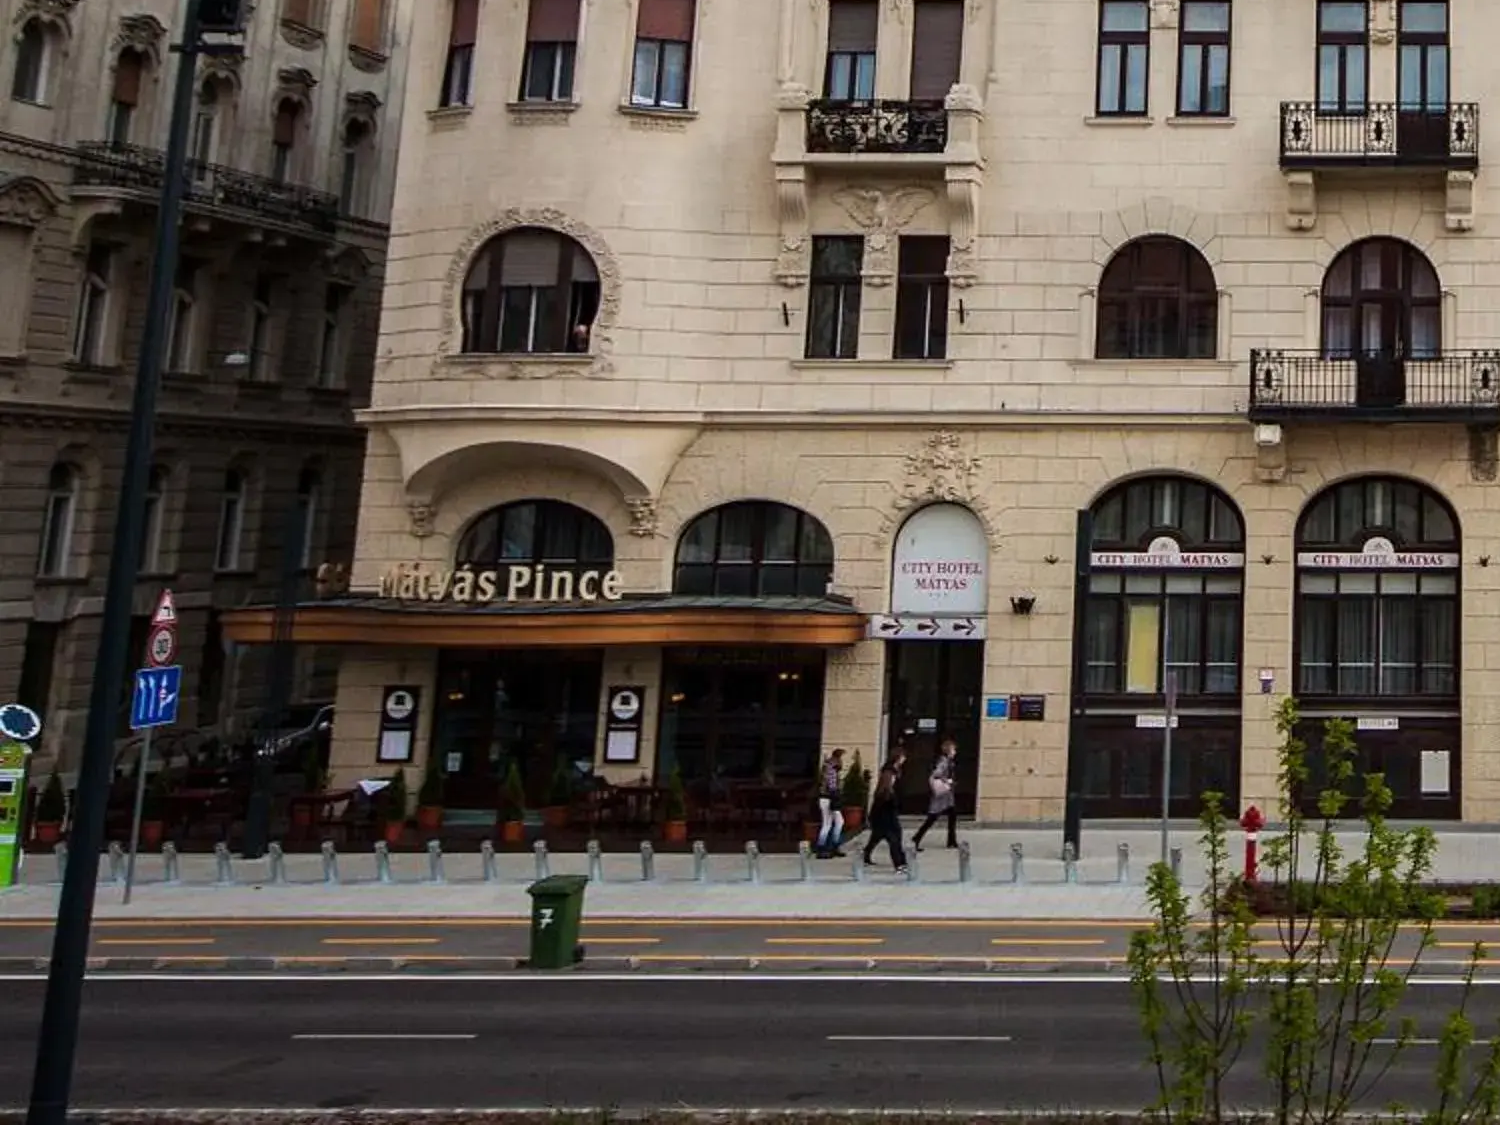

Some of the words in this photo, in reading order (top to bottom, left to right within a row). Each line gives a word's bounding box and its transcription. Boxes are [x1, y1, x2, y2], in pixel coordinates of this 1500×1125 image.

[1098, 554, 1126, 564] CITY
[1133, 554, 1174, 564] HOTEL
[1313, 554, 1342, 565] CITY
[1349, 554, 1389, 565] HOTEL
[901, 562, 935, 574] CITY
[937, 562, 983, 574] HOTEL
[507, 564, 625, 602] Pince
[539, 908, 555, 930] 7
